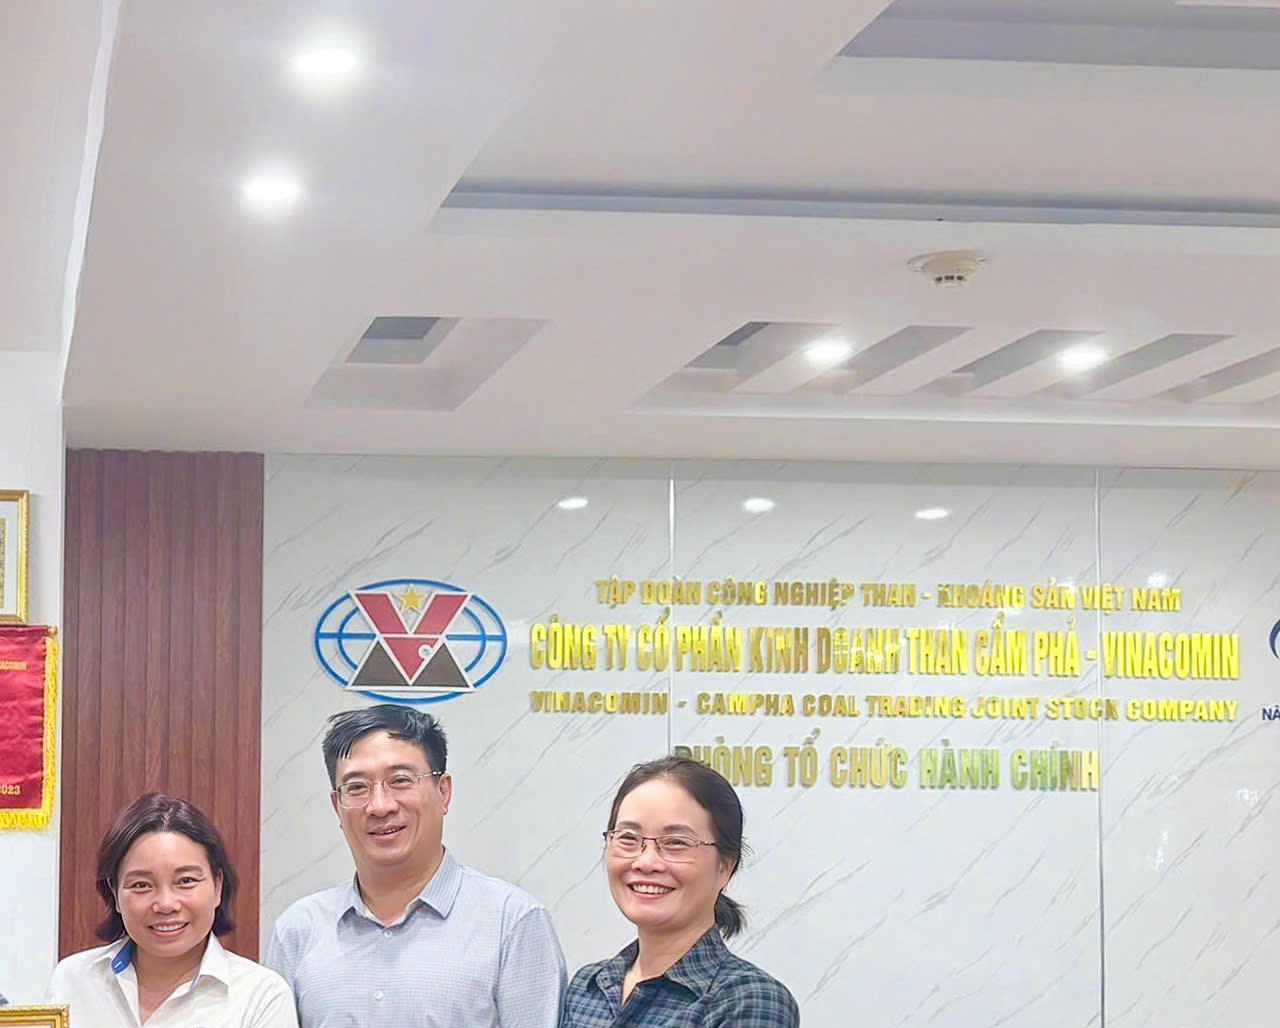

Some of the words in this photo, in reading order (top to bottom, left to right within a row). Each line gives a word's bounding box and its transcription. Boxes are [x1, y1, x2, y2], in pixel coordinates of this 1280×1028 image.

[595, 575, 636, 609] TẬP
[706, 576, 767, 606] CÔNG
[773, 577, 856, 611] NGHIỆP
[861, 583, 917, 607] THAN
[936, 579, 1026, 608] KHOÁNG
[1031, 577, 1076, 609] SẢN
[1080, 583, 1125, 615] VIỆT
[1131, 587, 1182, 612] NAM
[530, 614, 598, 671] CÔNG
[603, 624, 632, 671] TY
[637, 607, 671, 672] CỔ
[747, 627, 809, 673] KINH
[816, 627, 901, 674] DOANH
[904, 627, 969, 675] THAN
[974, 611, 1027, 676] CẨM
[1033, 616, 1081, 677] PHẢ
[1102, 632, 1240, 680] VINACOMIN
[529, 690, 668, 714] VINACOMIN
[696, 692, 795, 716] CAMPHA
[801, 694, 860, 717] COAL
[865, 695, 967, 718] TRADING
[970, 696, 1039, 719] JOINT
[1045, 697, 1118, 721] STOCK
[1126, 699, 1238, 722] COMPANY
[783, 728, 820, 787] TỔ
[830, 738, 908, 788] CHỨC
[920, 738, 1000, 789] HÀNH
[1010, 740, 1099, 790] CHÍNH
